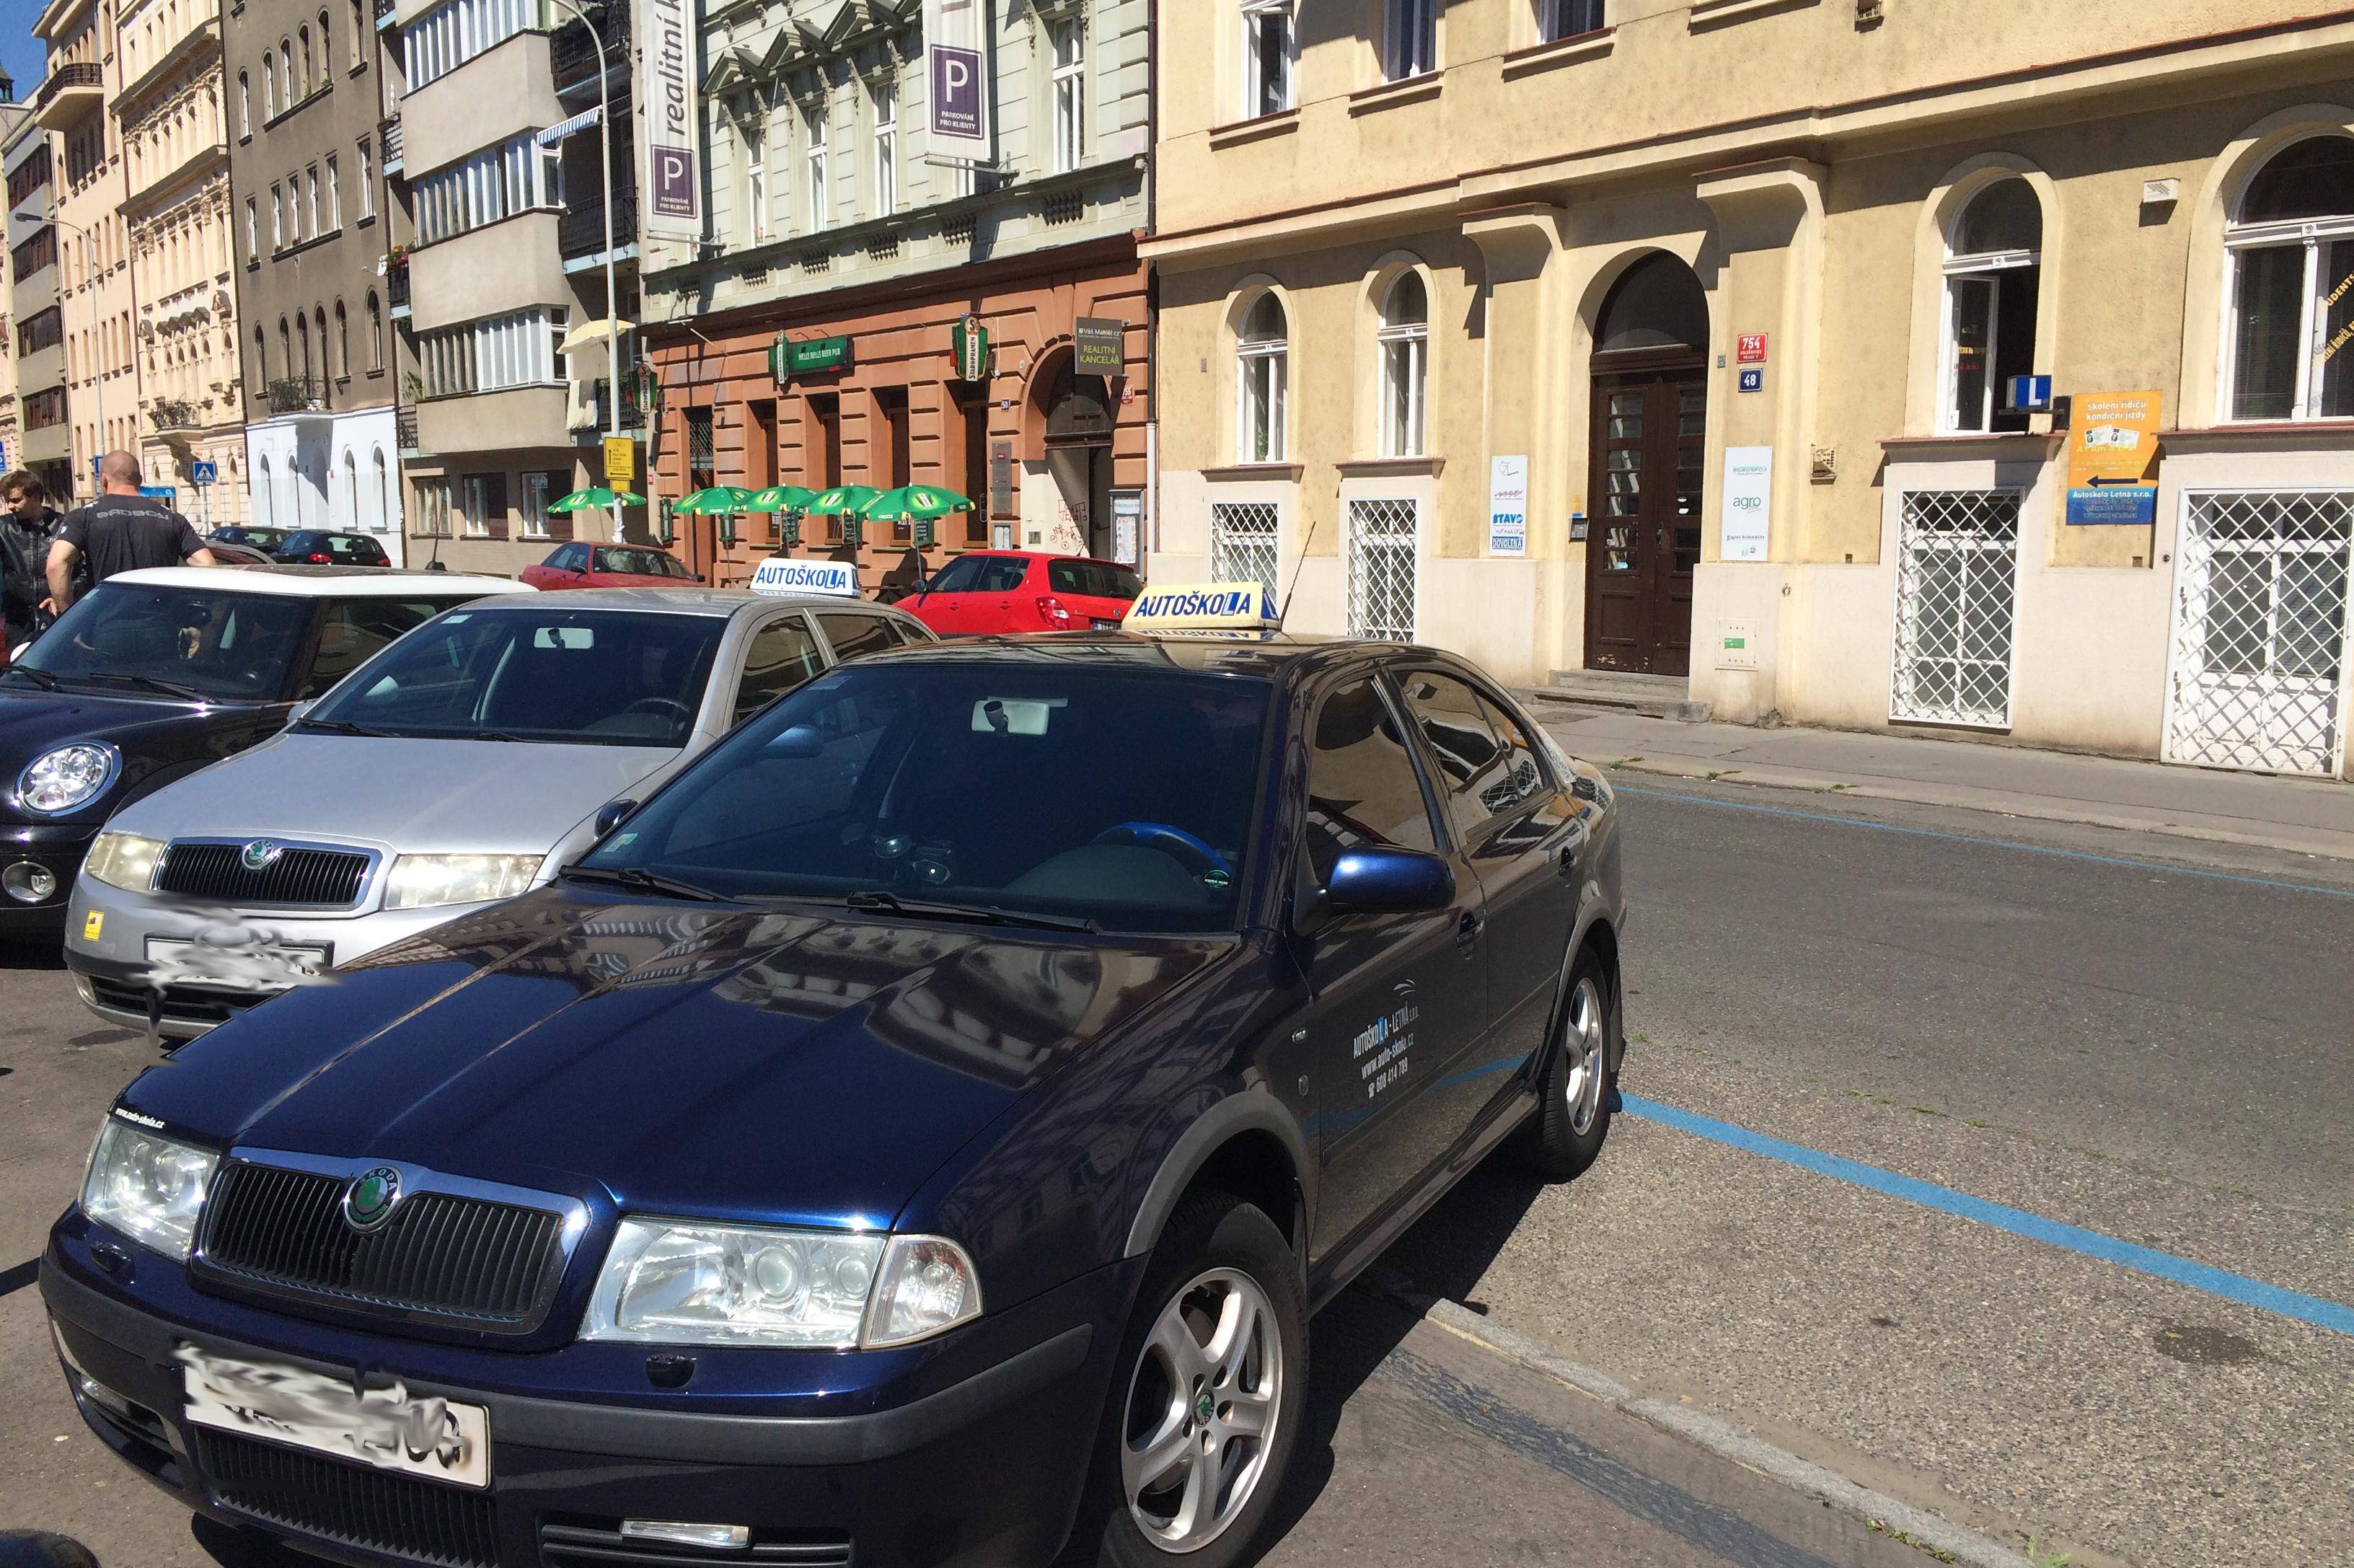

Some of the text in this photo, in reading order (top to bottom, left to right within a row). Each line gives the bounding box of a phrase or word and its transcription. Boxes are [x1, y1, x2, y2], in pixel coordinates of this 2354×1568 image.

[656, 12, 685, 136] realitní
[946, 60, 969, 103] P
[953, 120, 976, 130] KLIENTY
[664, 157, 684, 190] P
[832, 348, 841, 356] PUB
[1083, 345, 1116, 354] REALITNÍ
[1742, 337, 1760, 351] 754
[1080, 354, 1120, 365] KANCELÁŘ
[1744, 374, 1757, 387] 48
[2028, 377, 2042, 406] L
[1732, 496, 1761, 510] agro
[756, 565, 847, 589] AUTOŠKOLA
[1134, 591, 1251, 617] AUTOŠKOLA
[1353, 1017, 1389, 1060] AUTOŠKOLA
[1392, 1000, 1409, 1034] LETNÁ
